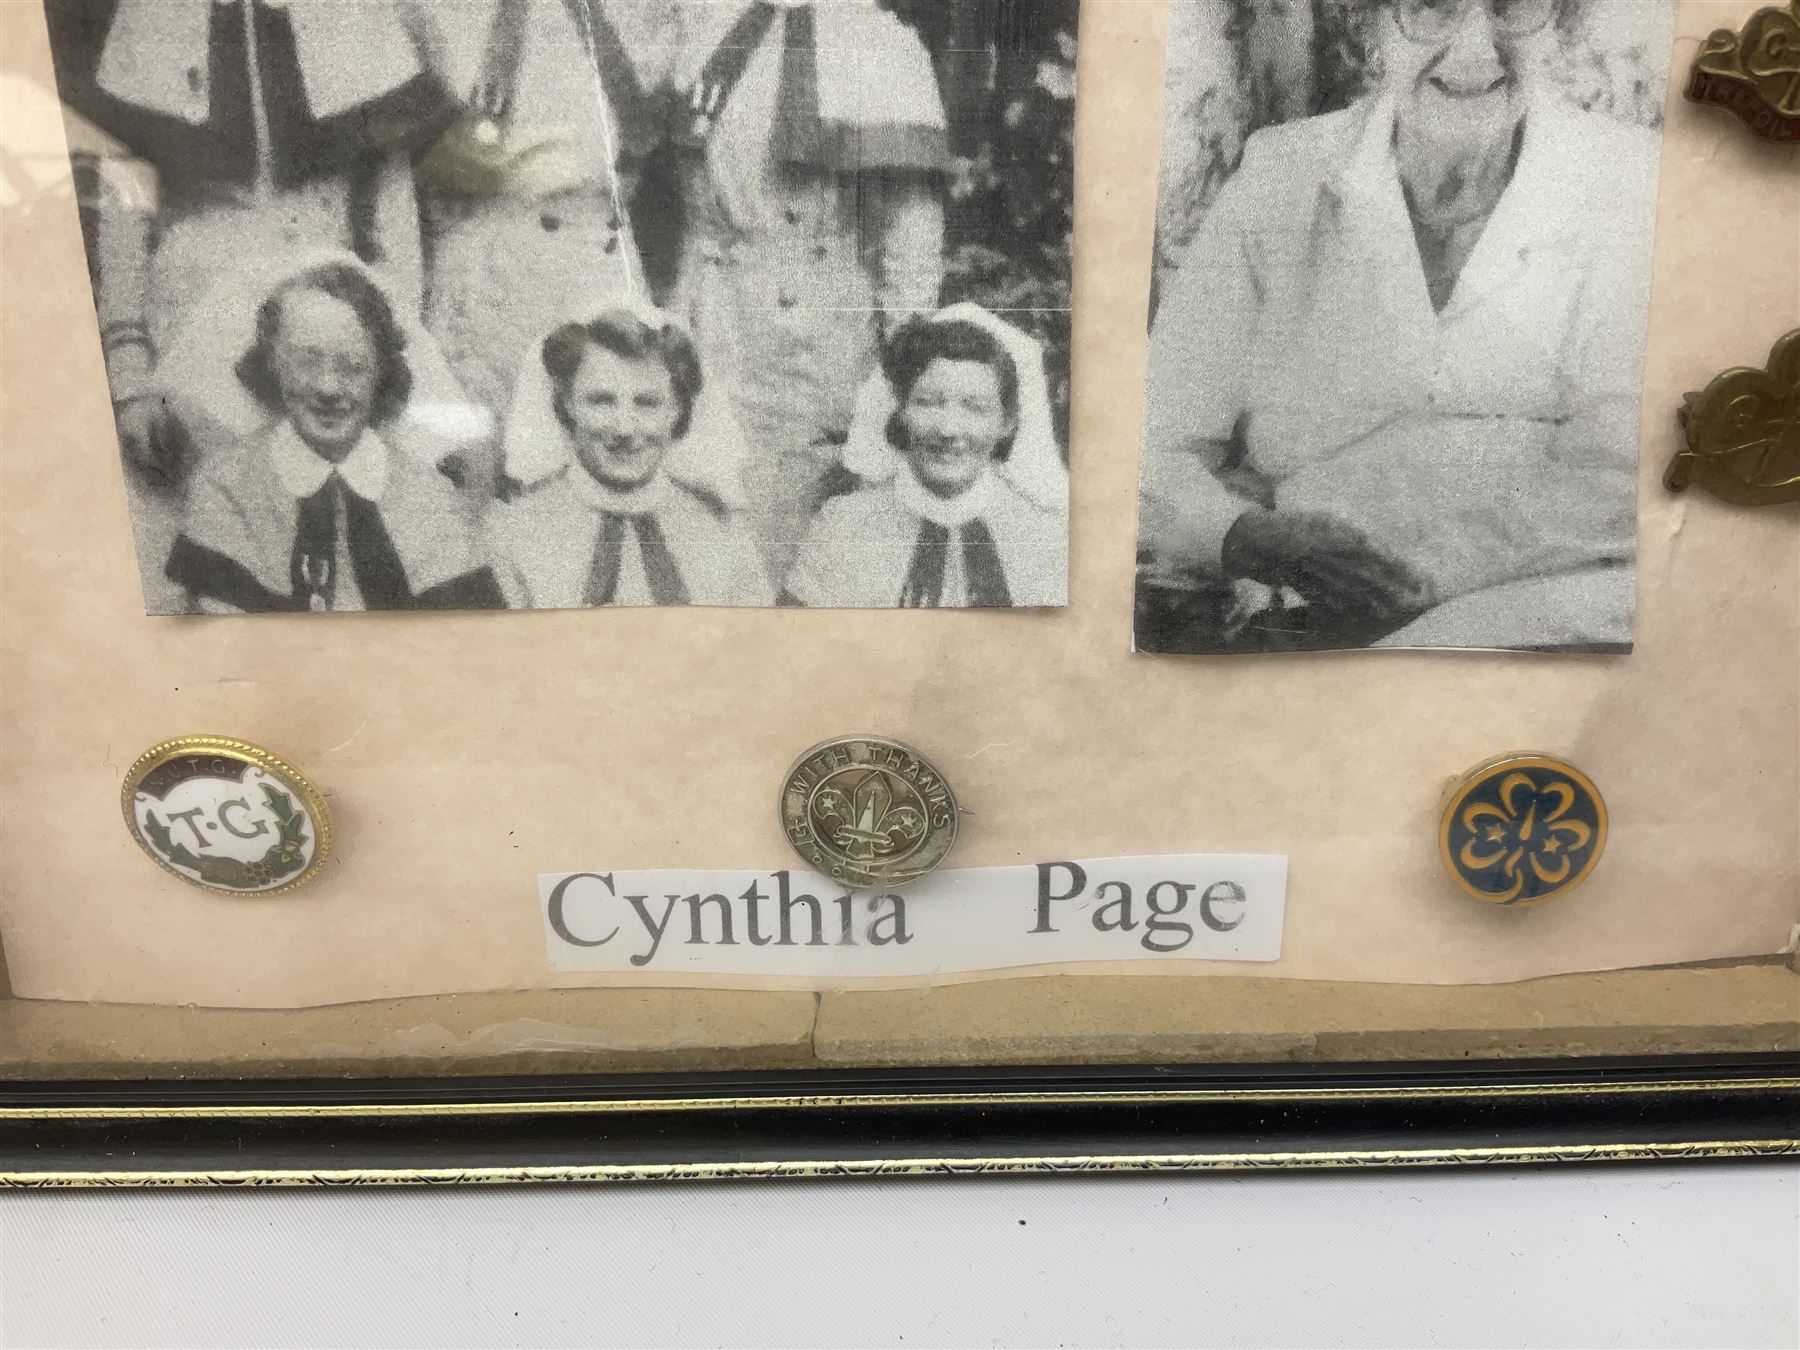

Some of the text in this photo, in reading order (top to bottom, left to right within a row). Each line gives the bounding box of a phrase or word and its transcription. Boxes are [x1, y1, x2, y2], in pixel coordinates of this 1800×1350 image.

[789, 745, 951, 829] WITH THANKS
[547, 860, 1247, 967] Cynthia Page
